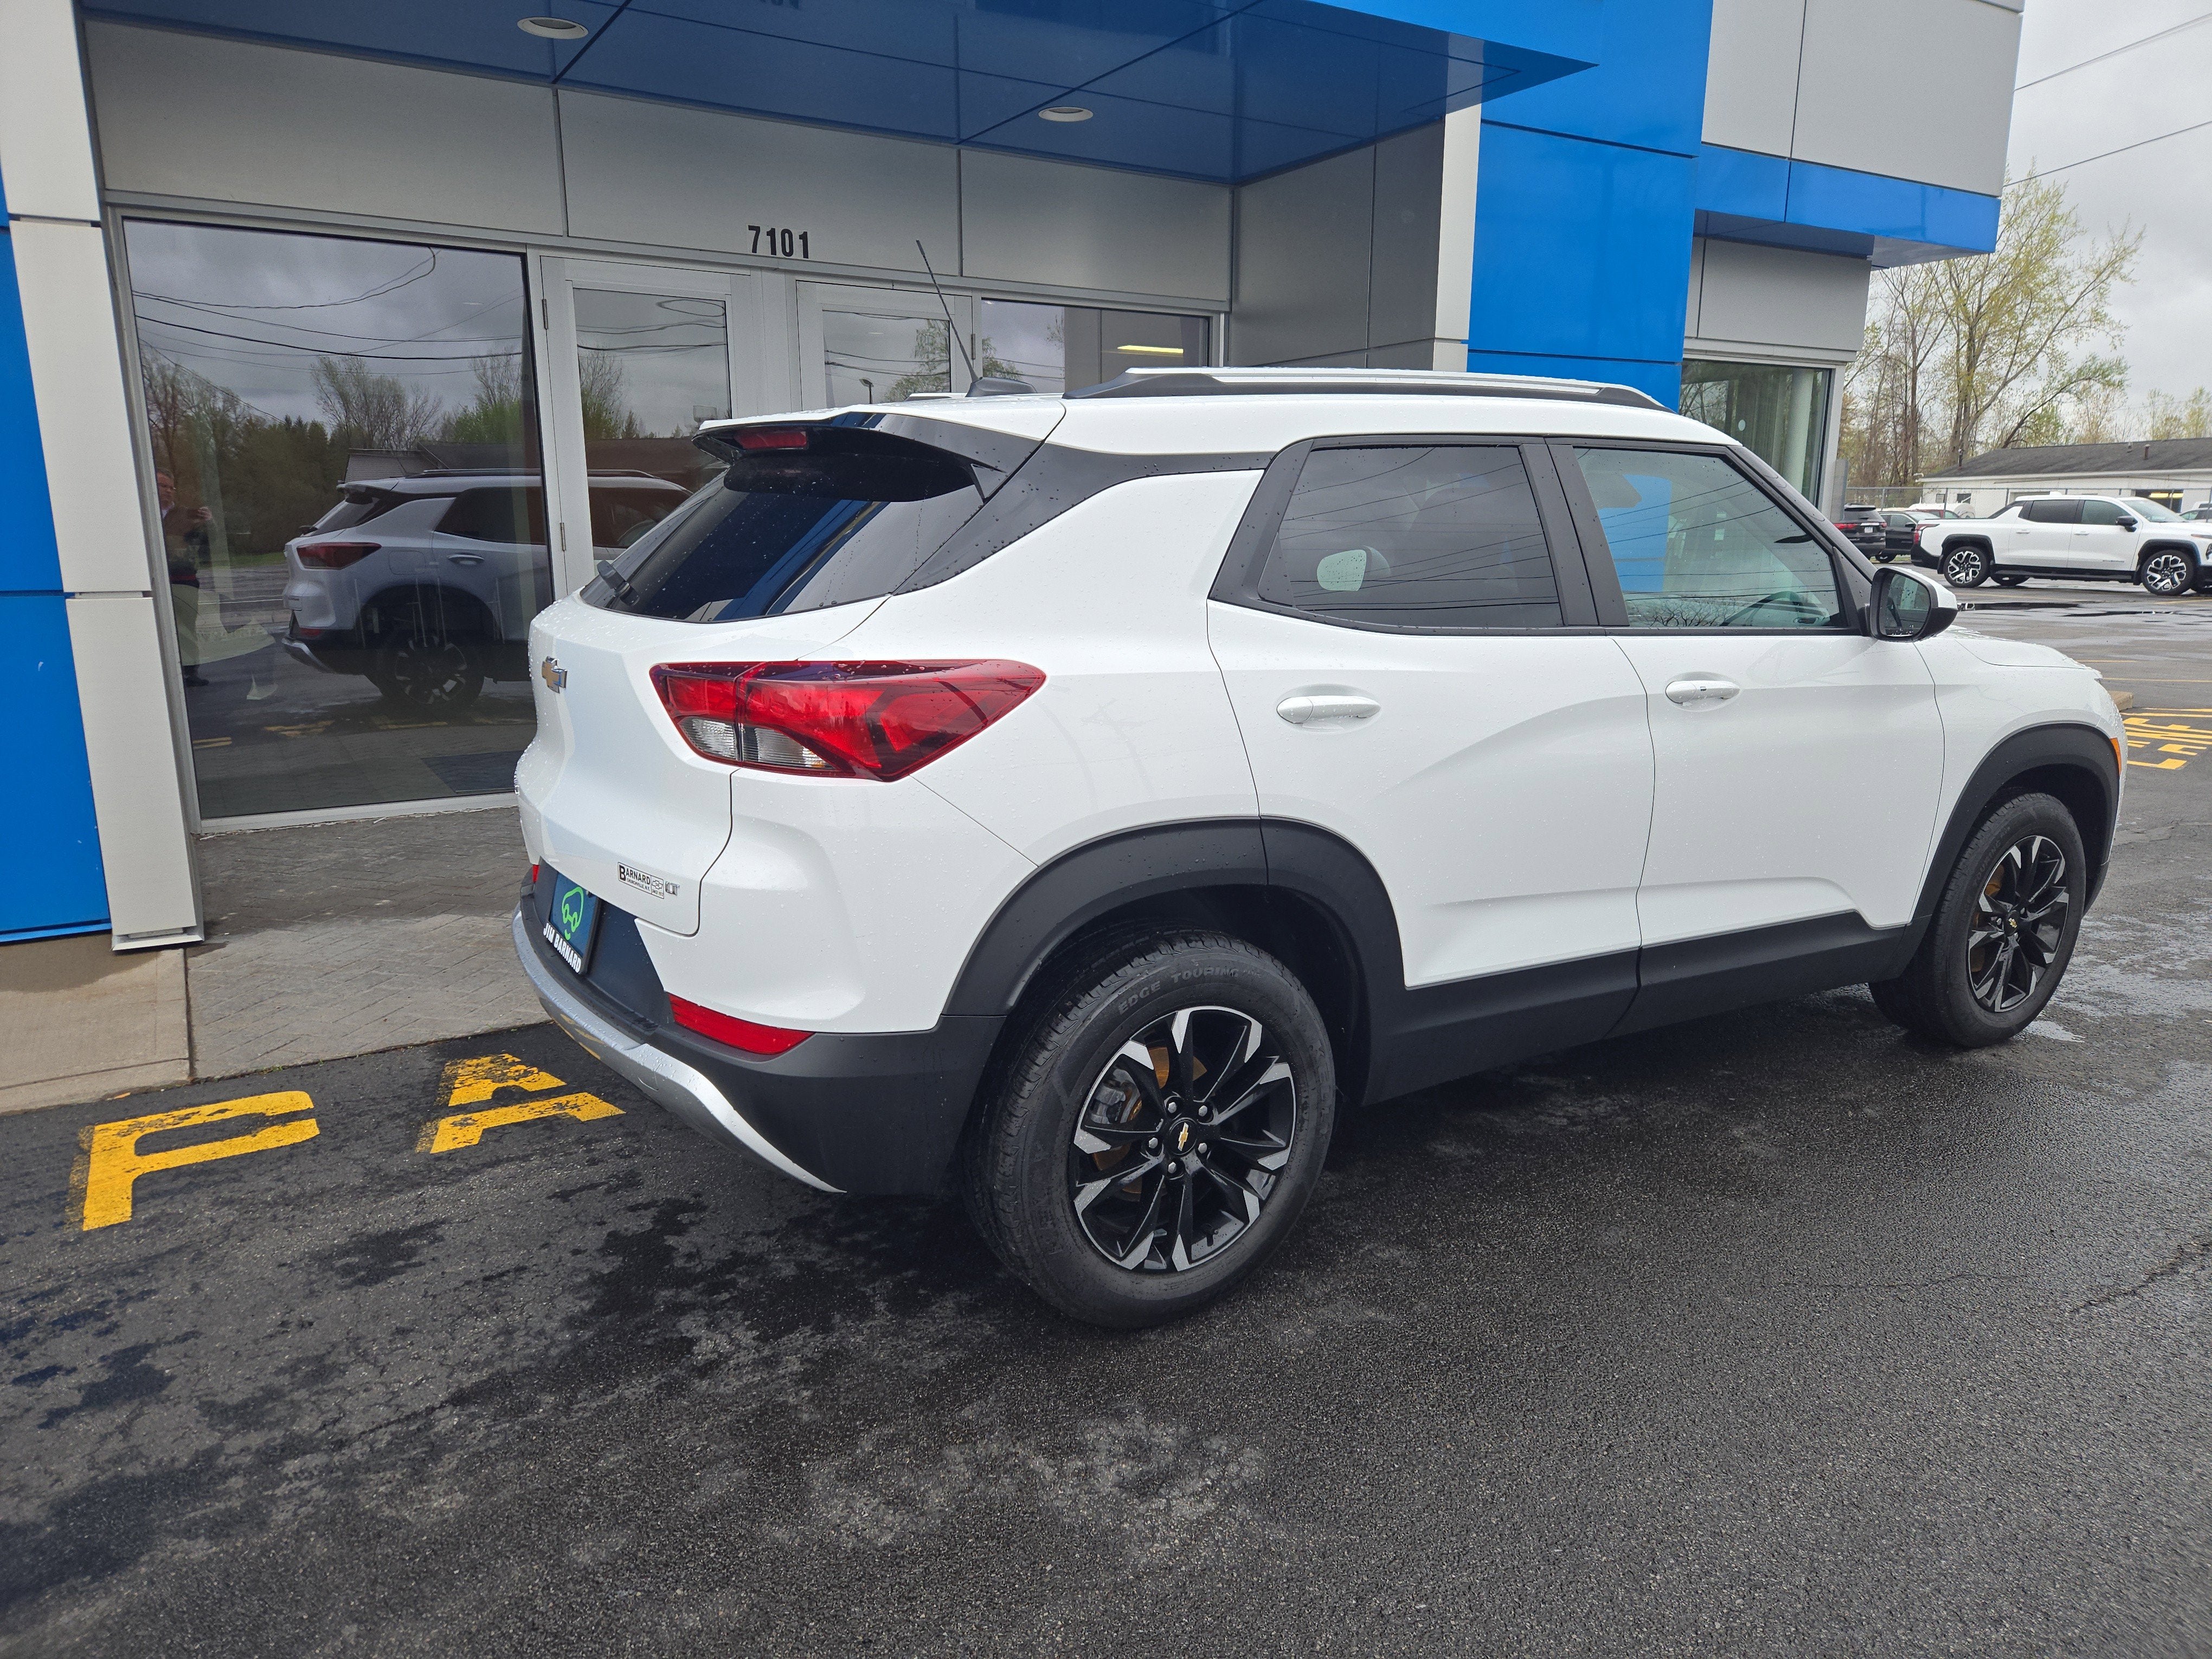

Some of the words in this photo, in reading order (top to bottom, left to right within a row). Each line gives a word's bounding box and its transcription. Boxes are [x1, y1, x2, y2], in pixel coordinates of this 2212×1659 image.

[748, 224, 809, 259] 7101
[619, 864, 651, 885] BARNARD
[543, 922, 555, 943] JIM
[554, 933, 582, 973] BARNARD
[1117, 980, 1161, 1015] EDGE
[1171, 967, 1240, 983] TOURING
